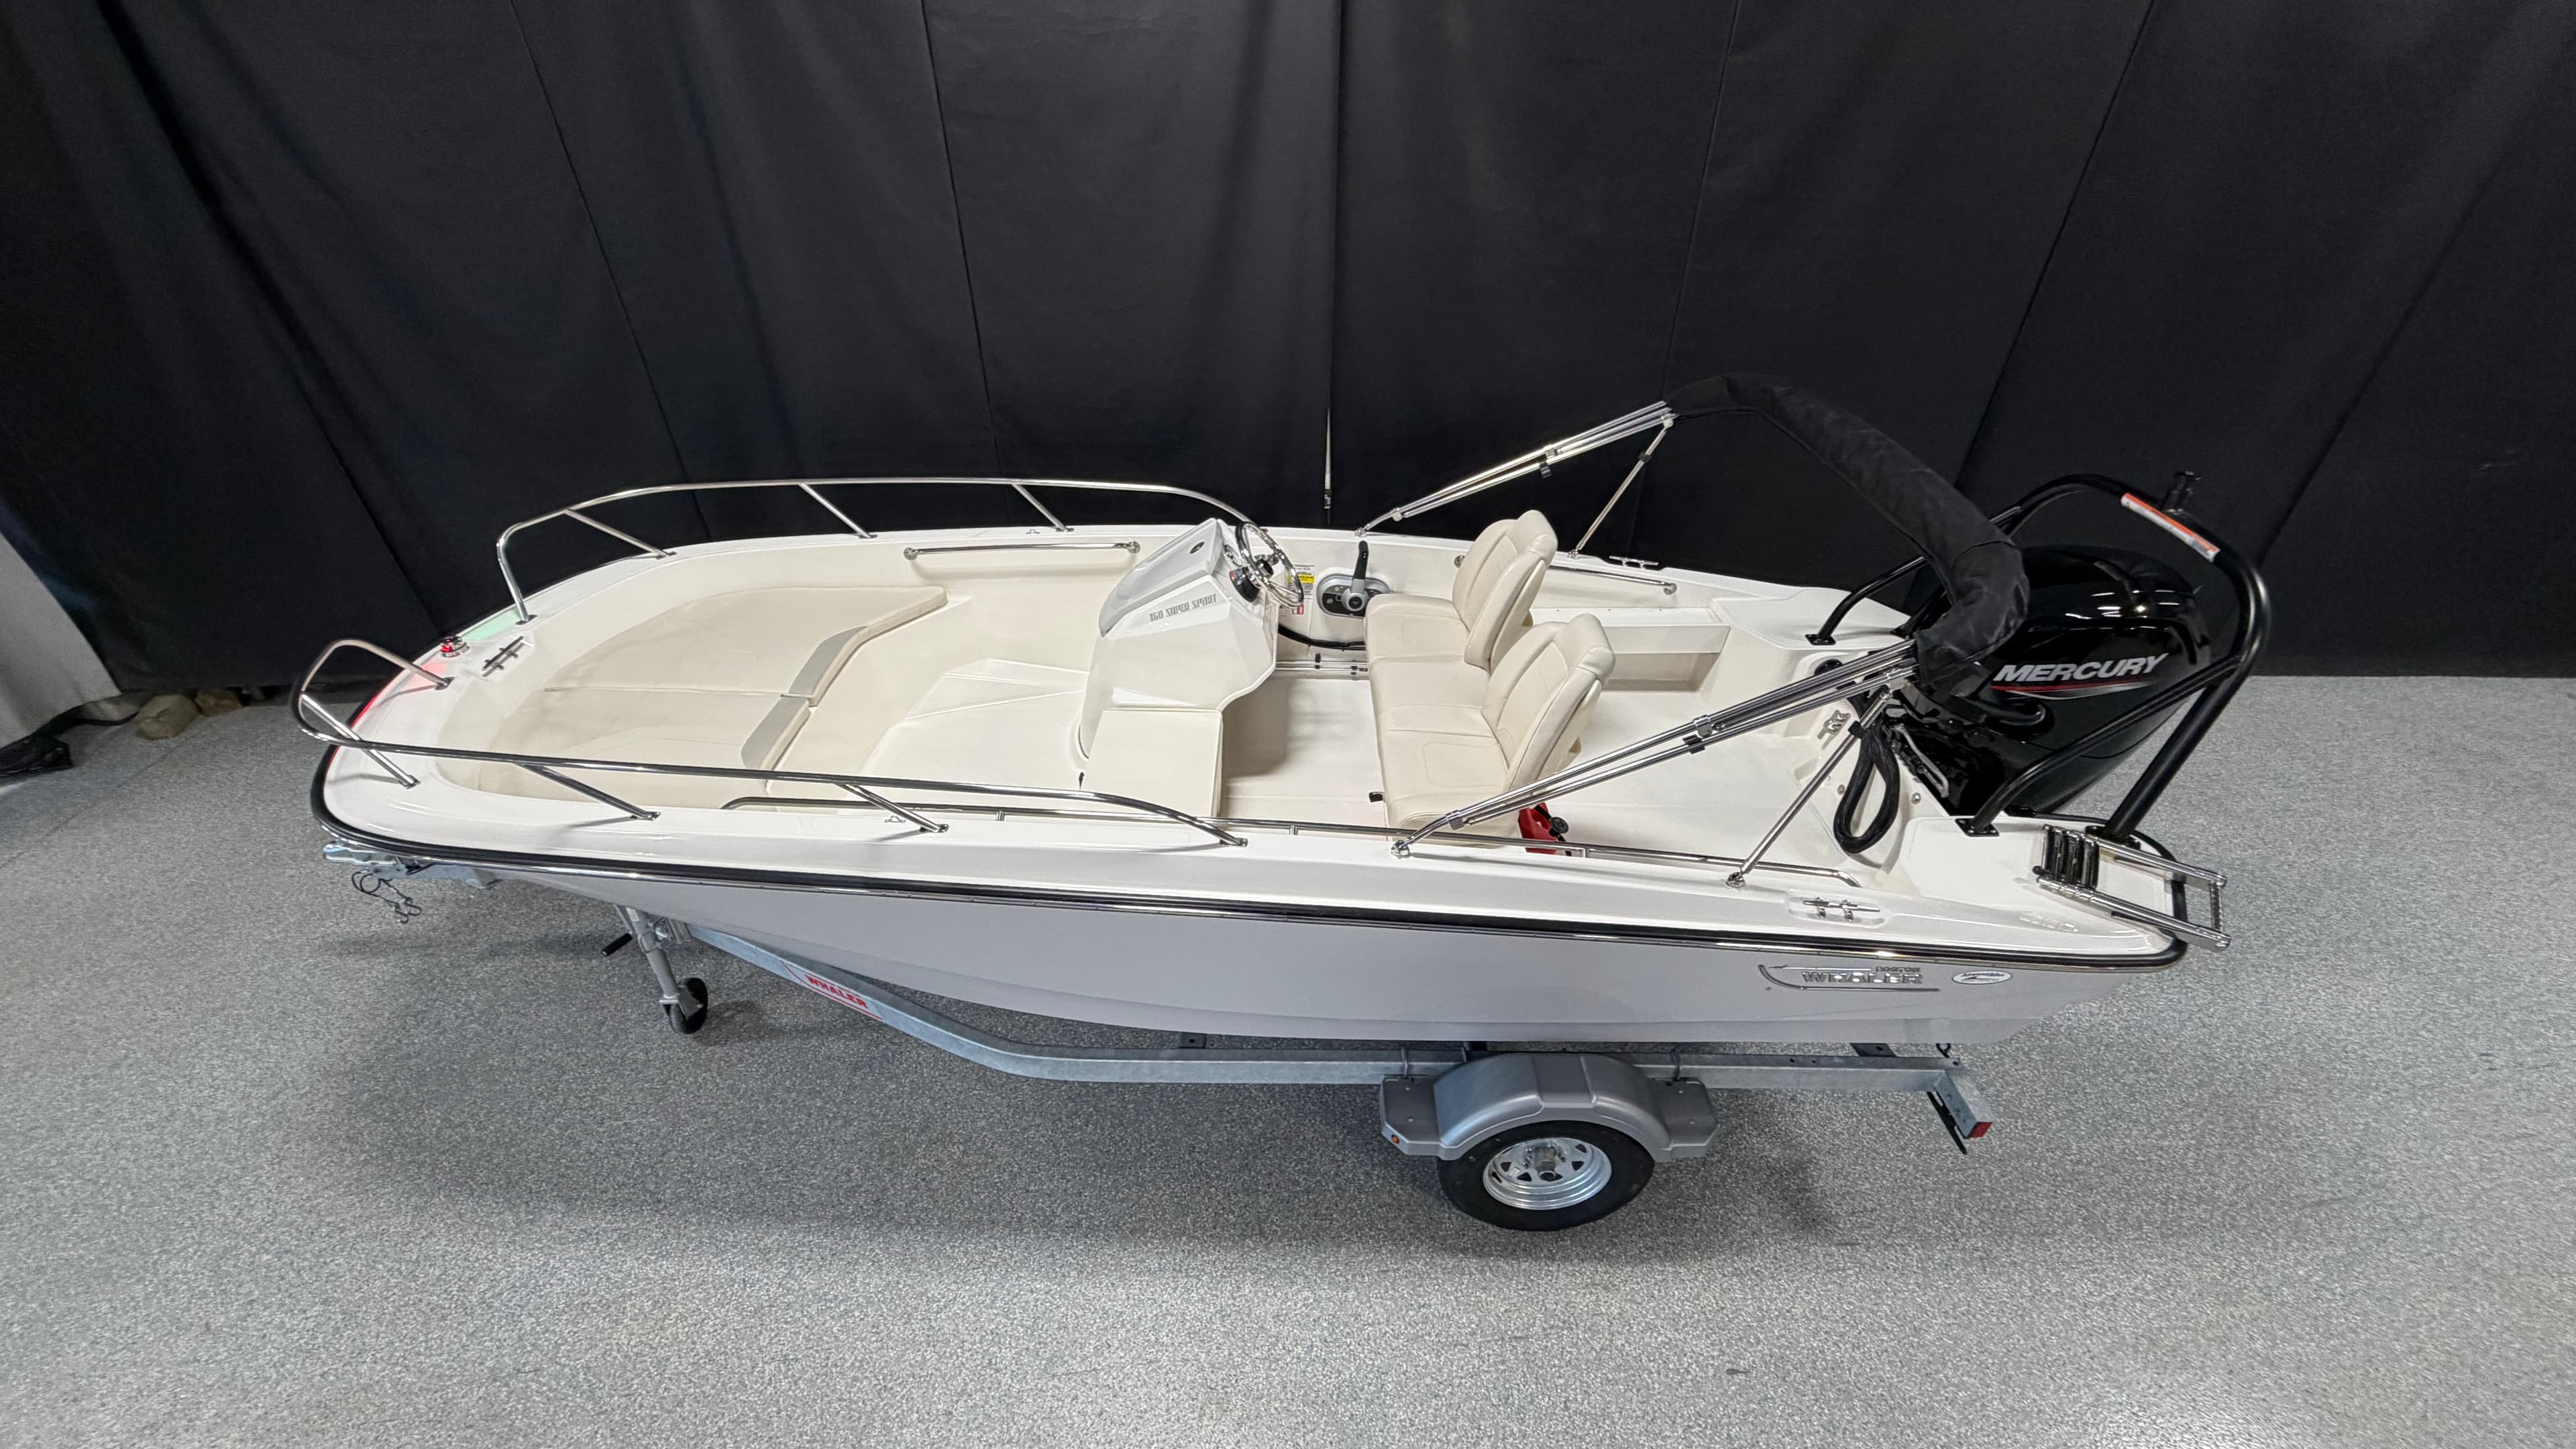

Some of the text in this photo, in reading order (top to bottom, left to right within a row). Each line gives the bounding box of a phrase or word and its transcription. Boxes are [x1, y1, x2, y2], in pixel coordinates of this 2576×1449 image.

[1149, 593, 1217, 622] 160 SUPER SPORT
[1993, 653, 2169, 682] MERCURY
[1803, 971, 1923, 984] WHALER
[806, 976, 869, 1009] WHALER
